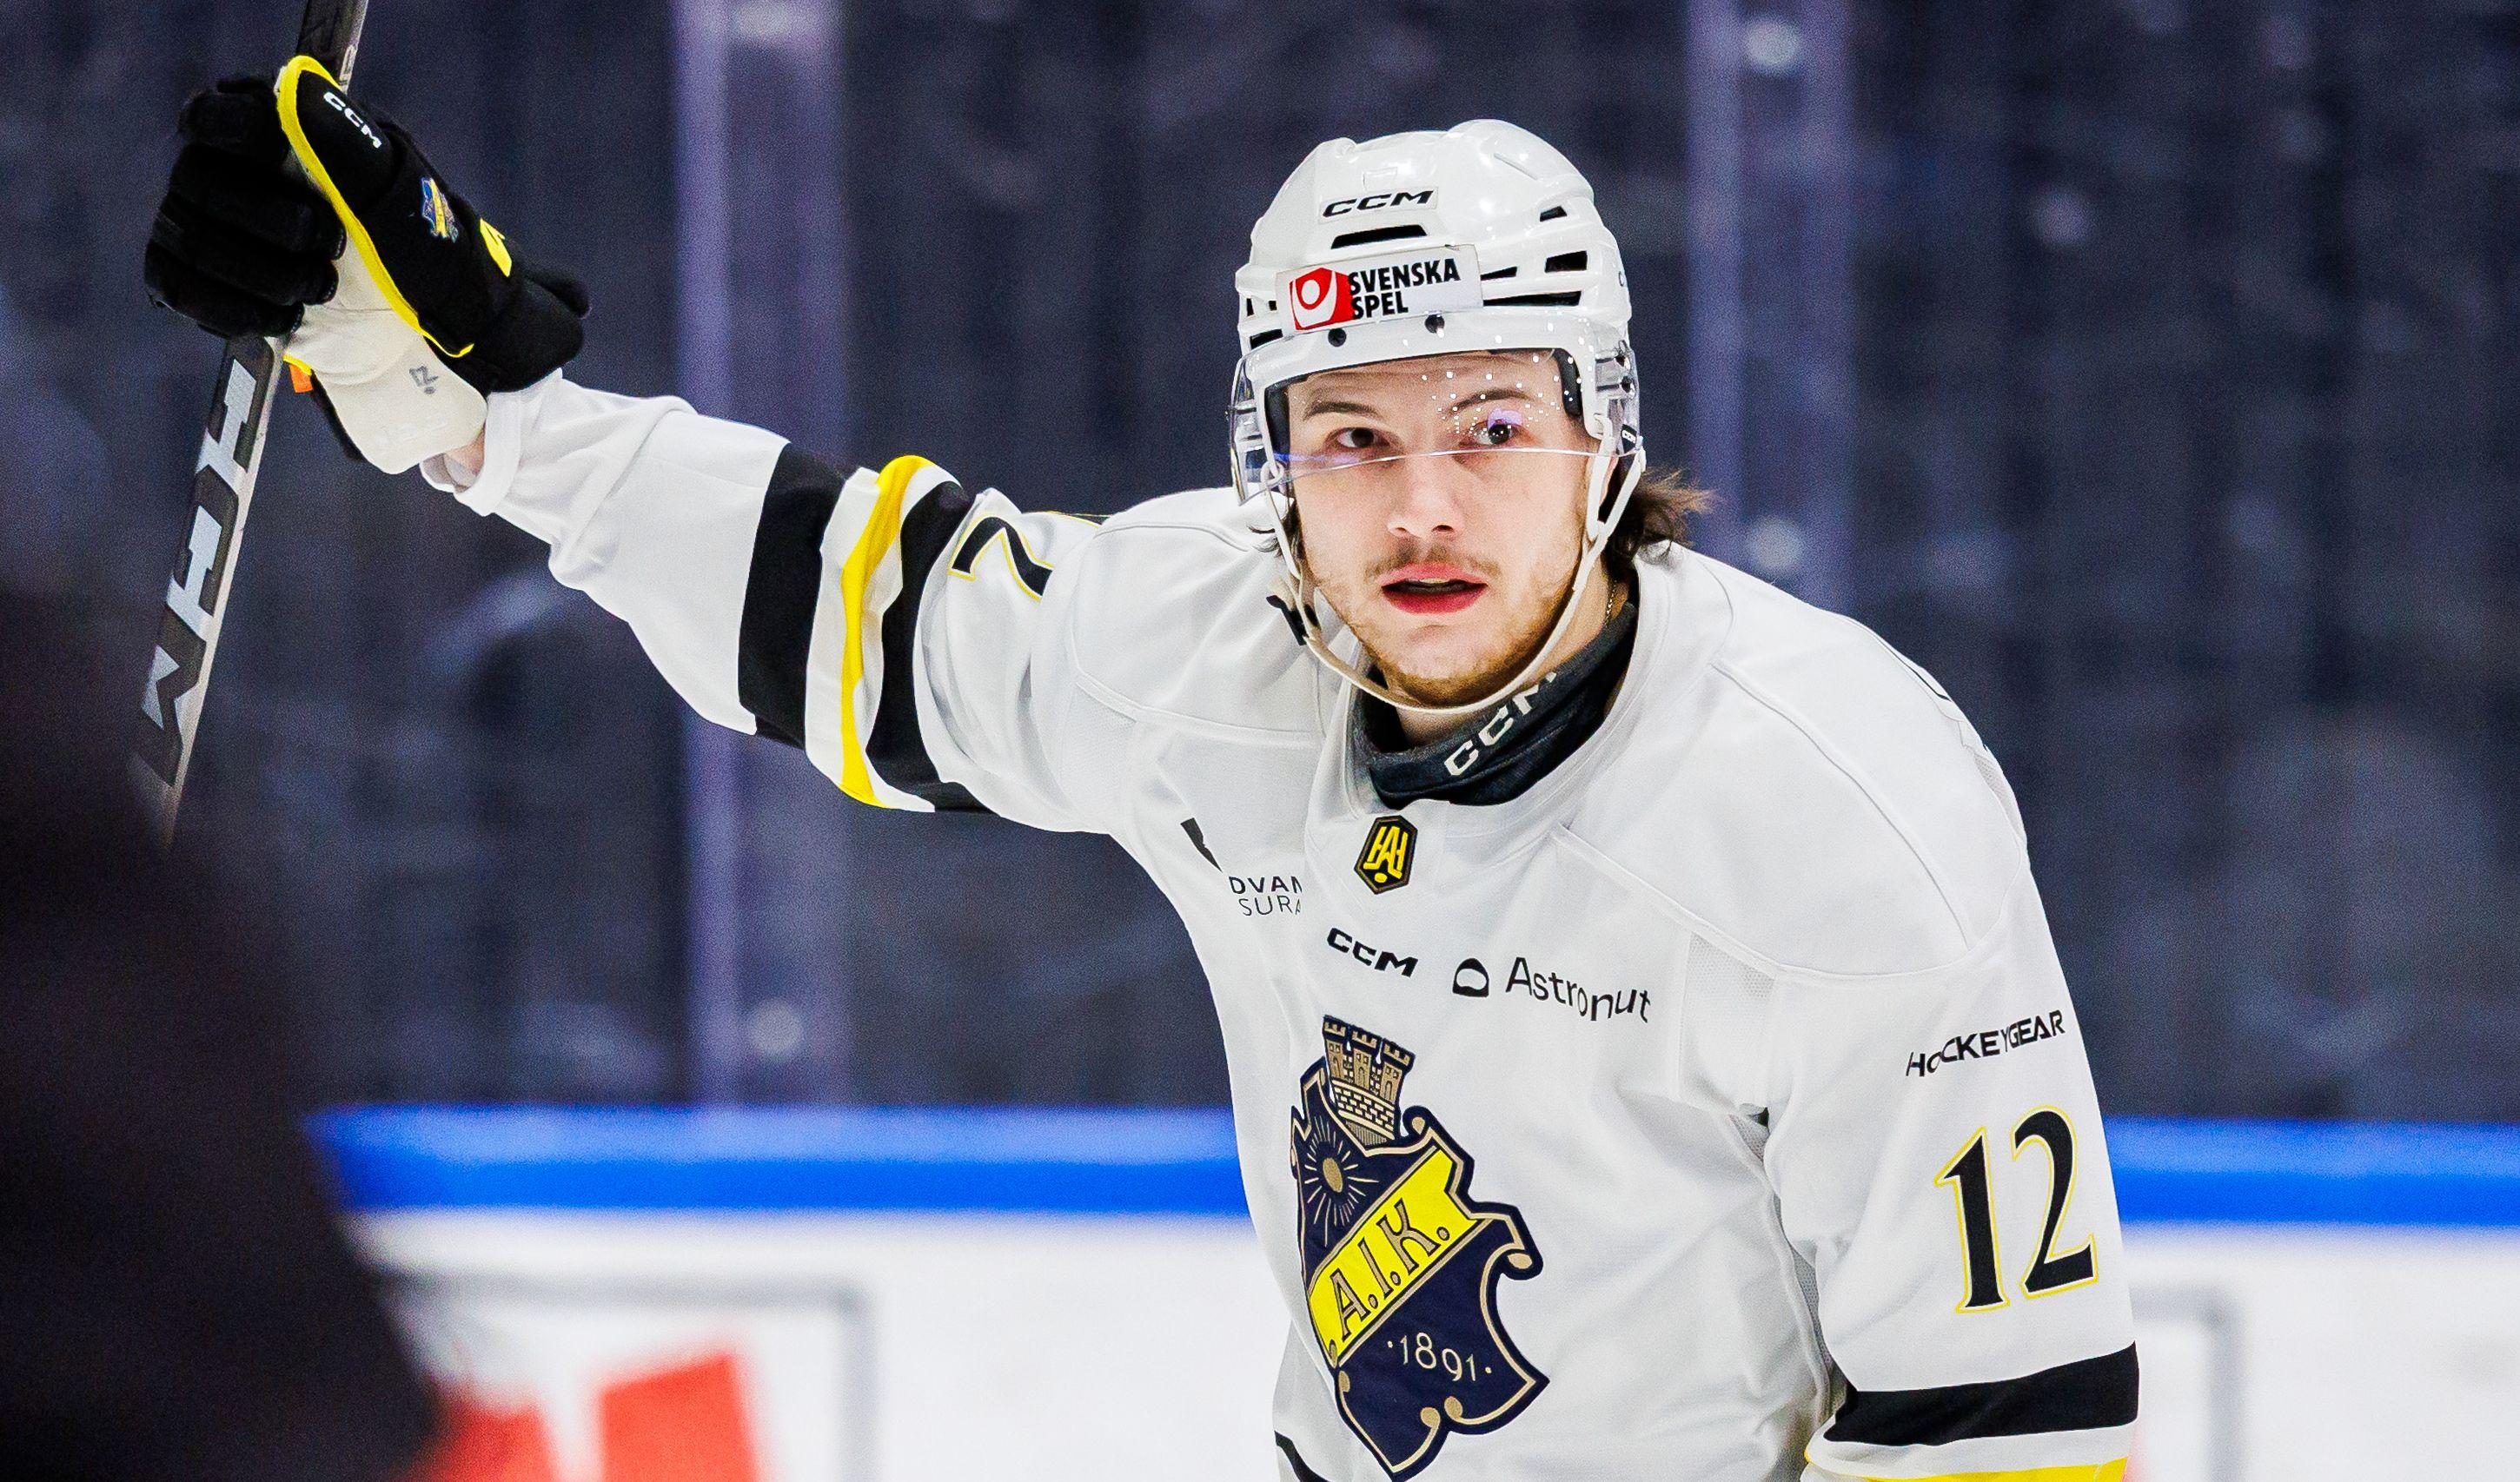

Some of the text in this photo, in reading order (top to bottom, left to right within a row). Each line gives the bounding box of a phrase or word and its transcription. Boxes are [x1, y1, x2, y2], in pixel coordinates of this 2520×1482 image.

[324, 91, 382, 149] CCM
[1322, 190, 1435, 218] CCM
[1348, 258, 1460, 295] SVENSKA
[1351, 291, 1409, 321] SPEL
[1326, 927, 1418, 977] CCM
[1934, 1105, 2099, 1313] 12
[1330, 1197, 1450, 1342] A.I.K.
